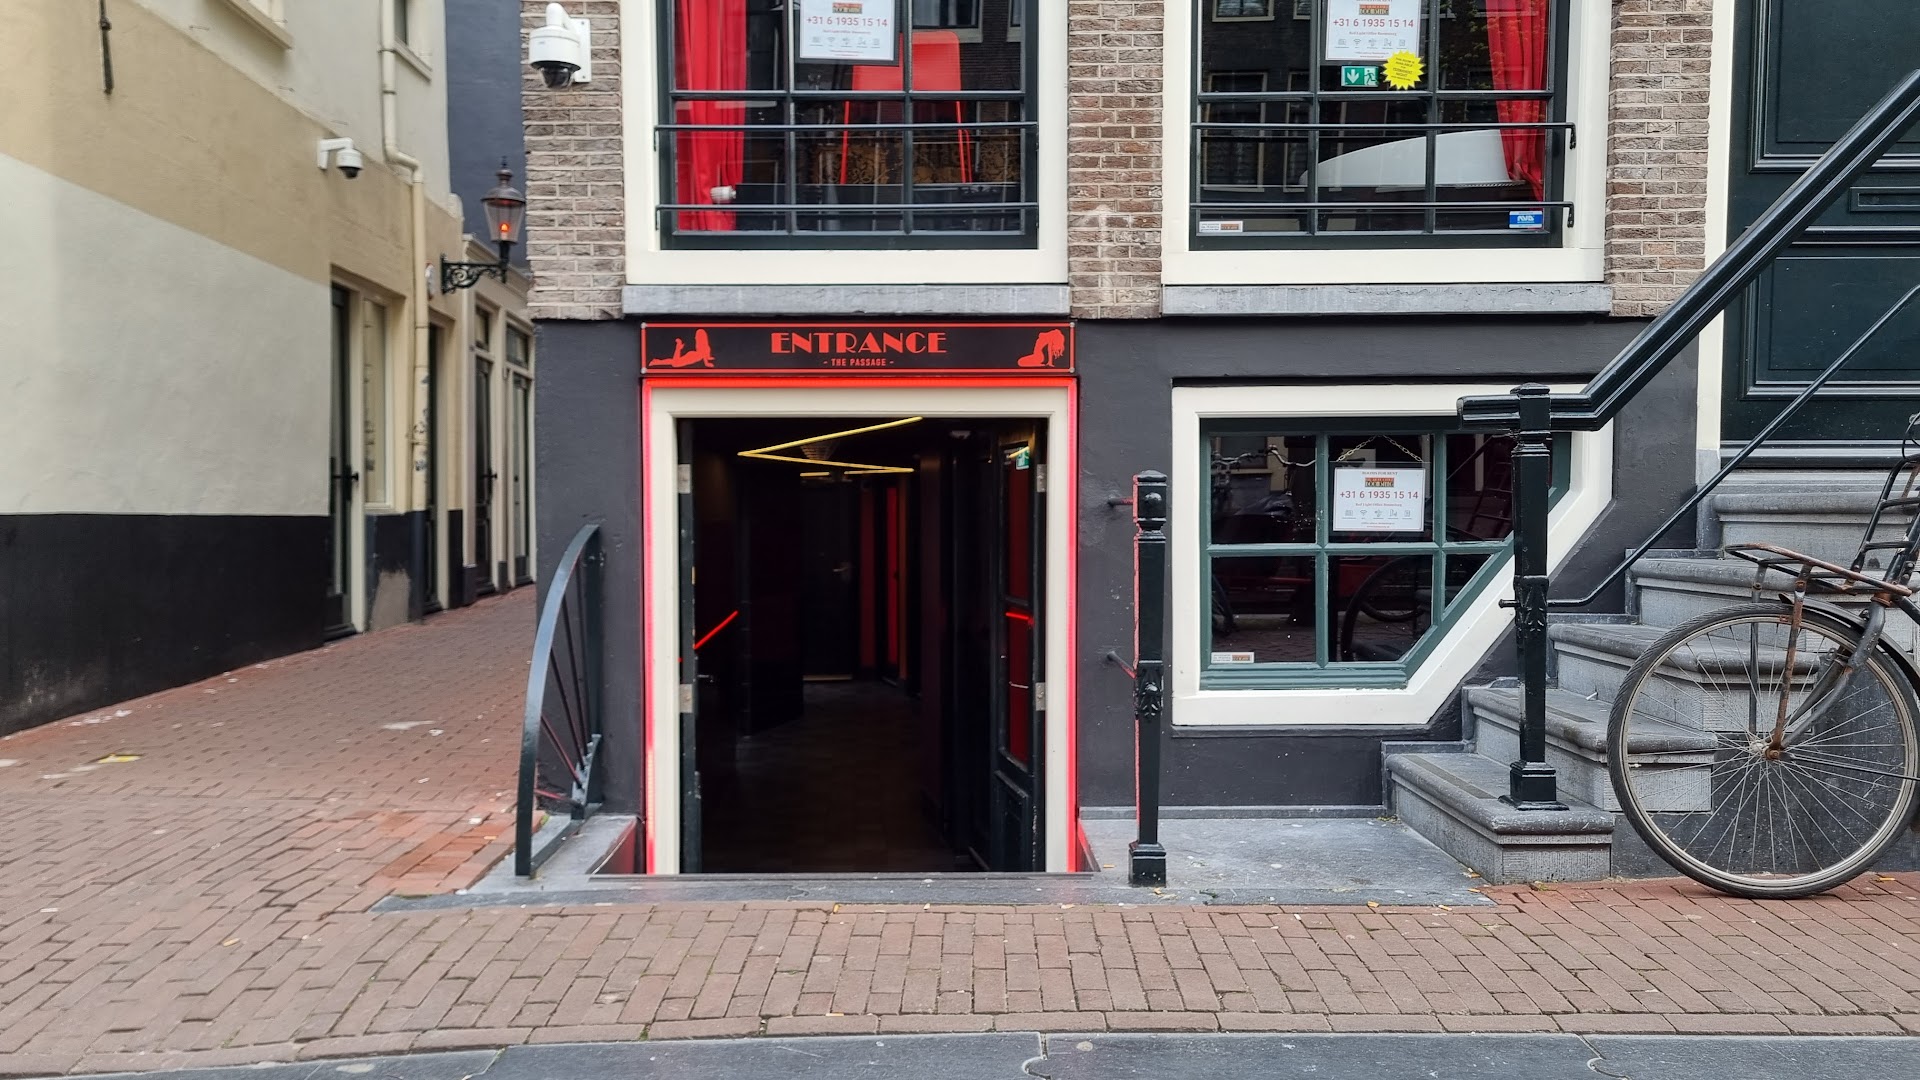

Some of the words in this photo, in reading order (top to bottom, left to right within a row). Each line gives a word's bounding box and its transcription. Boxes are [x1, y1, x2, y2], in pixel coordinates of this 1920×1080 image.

[806, 16, 824, 25] +31
[826, 16, 833, 25] 6
[835, 17, 859, 26] 1935
[862, 18, 874, 27] 15
[876, 18, 888, 27] 14
[1332, 18, 1350, 26] +31
[1353, 18, 1359, 27] 6
[1362, 18, 1386, 27] 1935
[1388, 19, 1400, 27] 15
[1402, 19, 1414, 28] 14
[771, 332, 946, 353] ENTRANCE
[831, 358, 847, 366] THE
[850, 358, 887, 366] PASSAGE
[1340, 490, 1356, 499] +31
[1359, 490, 1366, 499] 6
[1368, 490, 1391, 499] 1935
[1394, 490, 1405, 499] 15
[1408, 491, 1419, 500] 14
